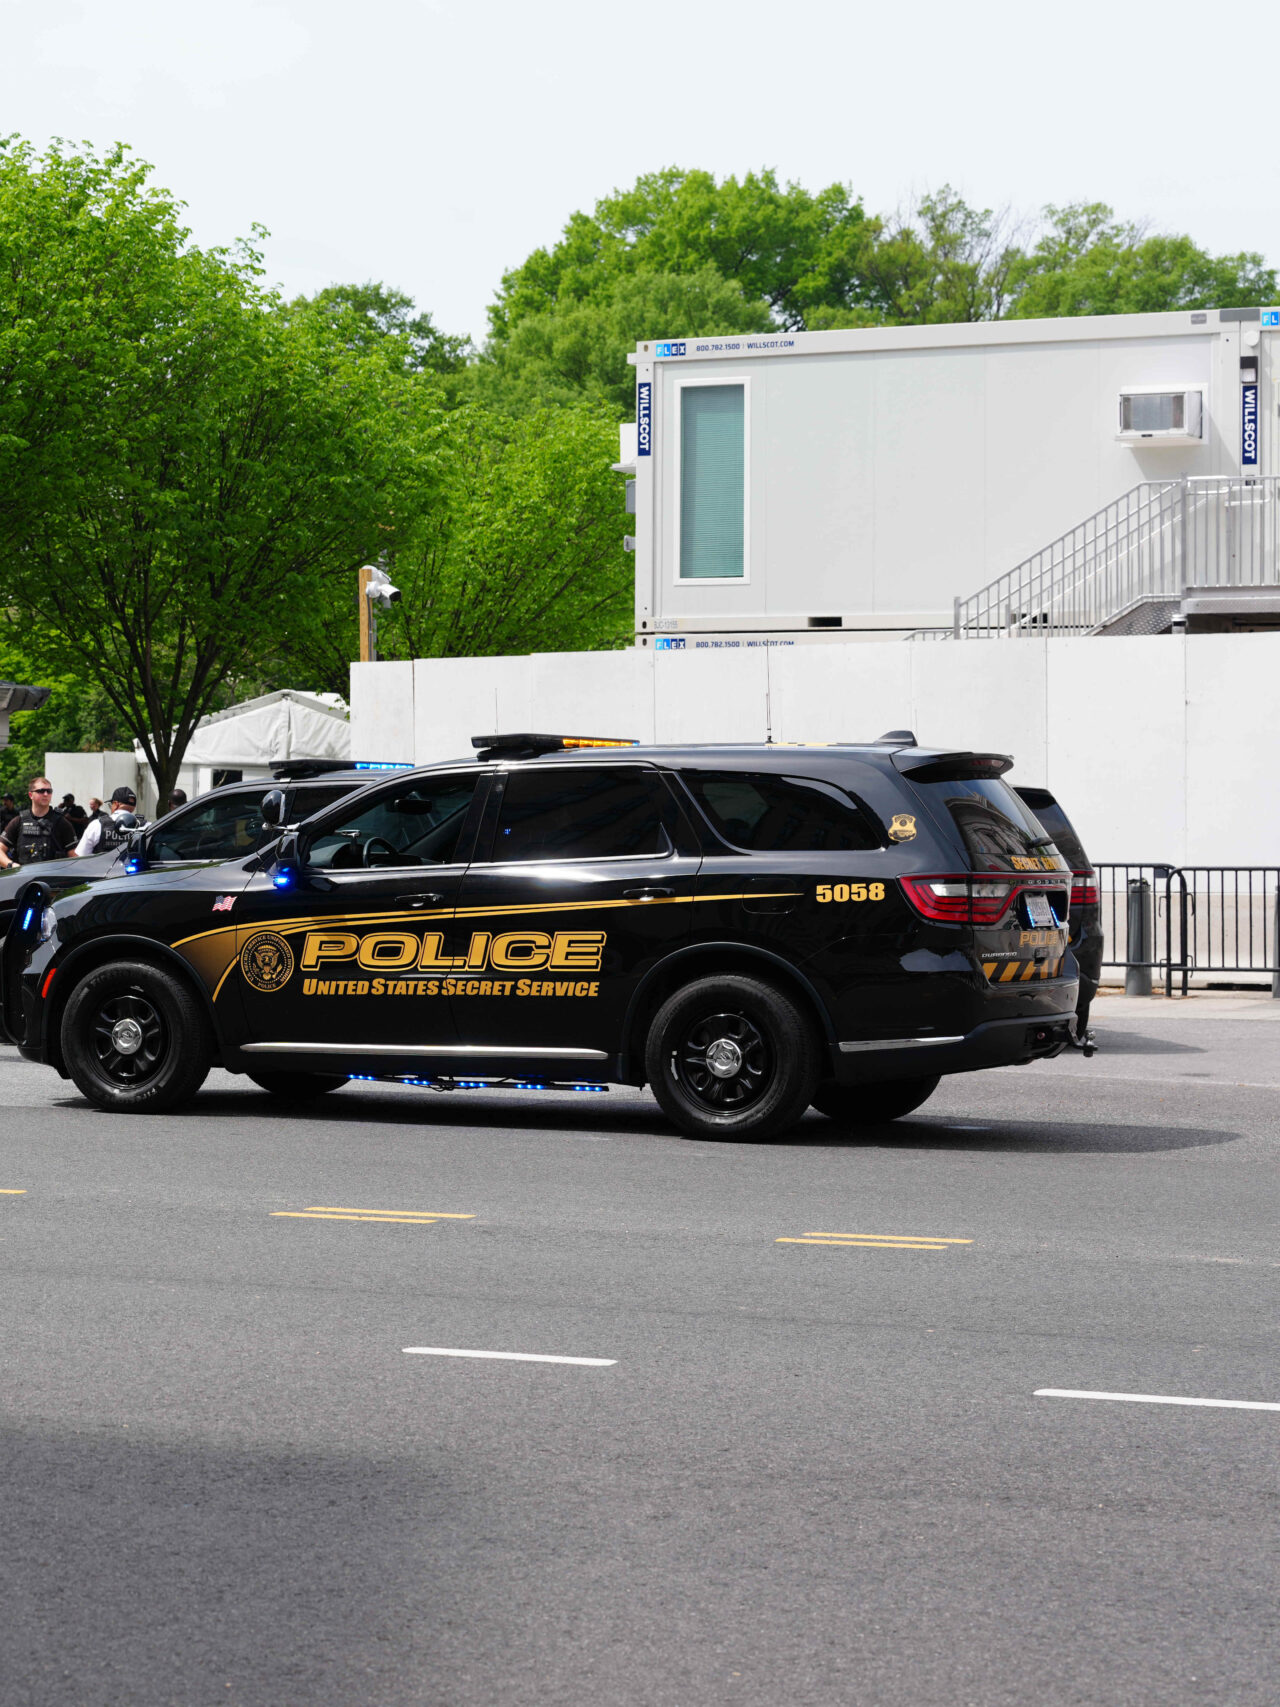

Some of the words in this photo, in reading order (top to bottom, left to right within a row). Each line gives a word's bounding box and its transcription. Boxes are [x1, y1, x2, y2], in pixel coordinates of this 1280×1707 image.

[656, 344, 685, 355] FLEX
[696, 343, 740, 352] 800.782.1500
[747, 340, 795, 349] WILLSCOT.COM
[639, 386, 649, 450] WILLSCOT
[1244, 389, 1256, 459] WILLSCOT
[816, 882, 885, 903] 5058
[300, 931, 607, 972] POLICE
